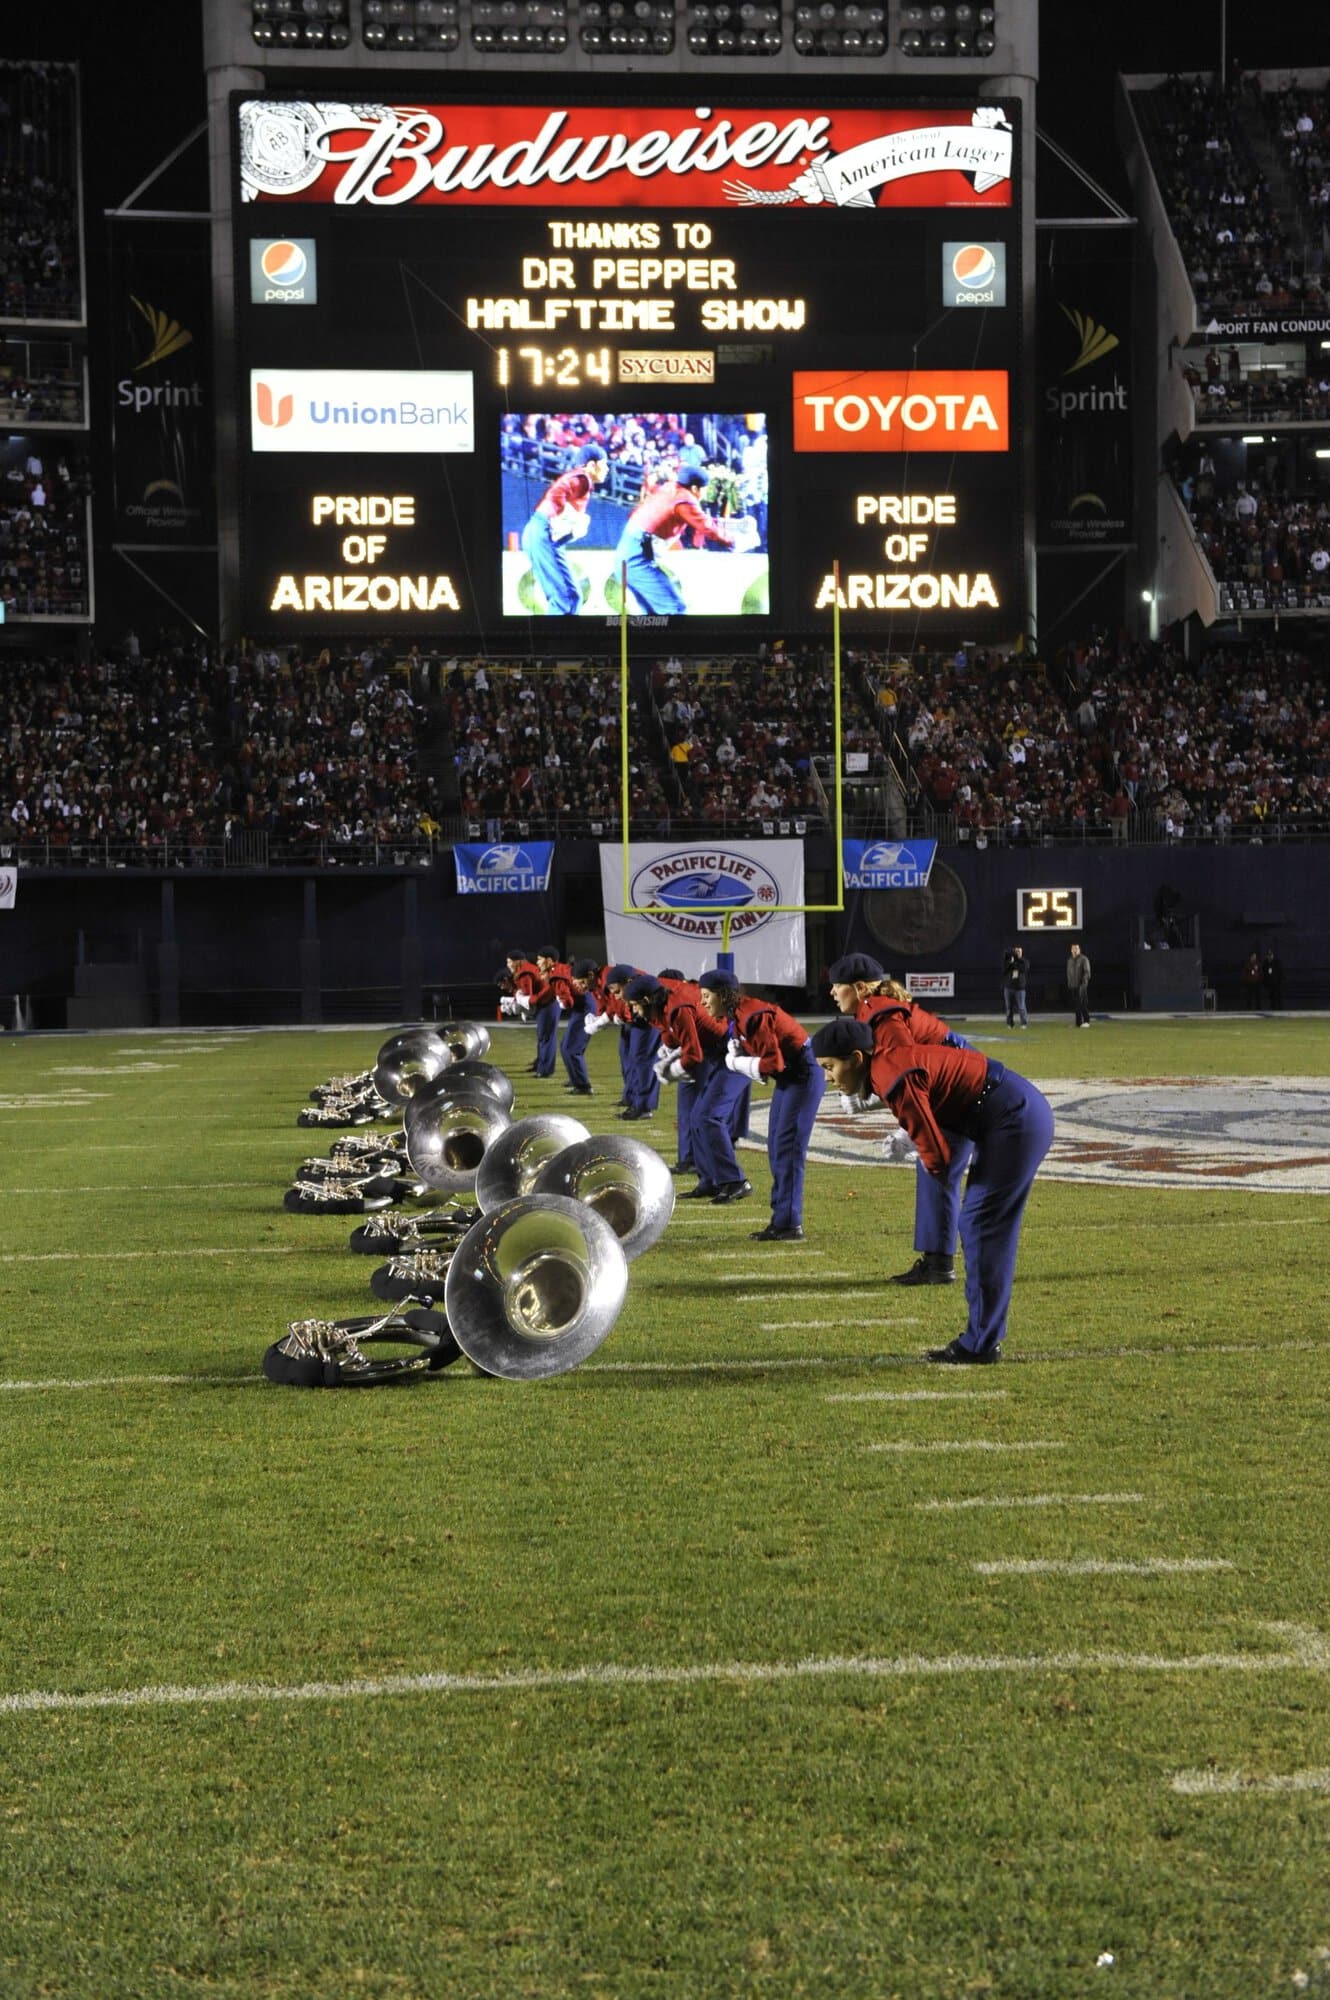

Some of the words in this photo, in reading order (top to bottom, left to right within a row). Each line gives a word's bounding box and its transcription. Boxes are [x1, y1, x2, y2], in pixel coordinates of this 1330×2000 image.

[311, 108, 830, 205] Budweiser
[840, 147, 937, 190] American
[944, 140, 1005, 164] Lager
[548, 222, 660, 248] THANKS
[673, 223, 711, 248] TO
[523, 258, 576, 289] DR
[593, 258, 737, 289] PEPPER
[264, 286, 305, 302] pepsi
[956, 289, 994, 304] pepsi
[466, 299, 675, 330] HALFTIME
[702, 299, 806, 330] SHOW
[1253, 321, 1279, 333] FAN
[498, 347, 611, 386] 17:24
[621, 357, 712, 375] SYCUAN
[117, 380, 203, 413] Sprint
[1045, 384, 1128, 419] Sprint
[310, 401, 468, 425] UnionBank
[804, 395, 998, 432] TOYOTA
[312, 496, 415, 525] PRIDE
[856, 495, 956, 525] PRIDE
[342, 536, 387, 564] OF
[885, 534, 928, 562] OF
[270, 576, 460, 611] ARIZONA
[815, 574, 1000, 609] ARIZONA
[650, 856, 717, 880] PACIFIC
[718, 855, 757, 881] LIFE
[843, 871, 901, 888] PACIFIC
[457, 875, 518, 894] PACIFIC
[1027, 892, 1073, 927] 25
[910, 976, 950, 987] ESPN
